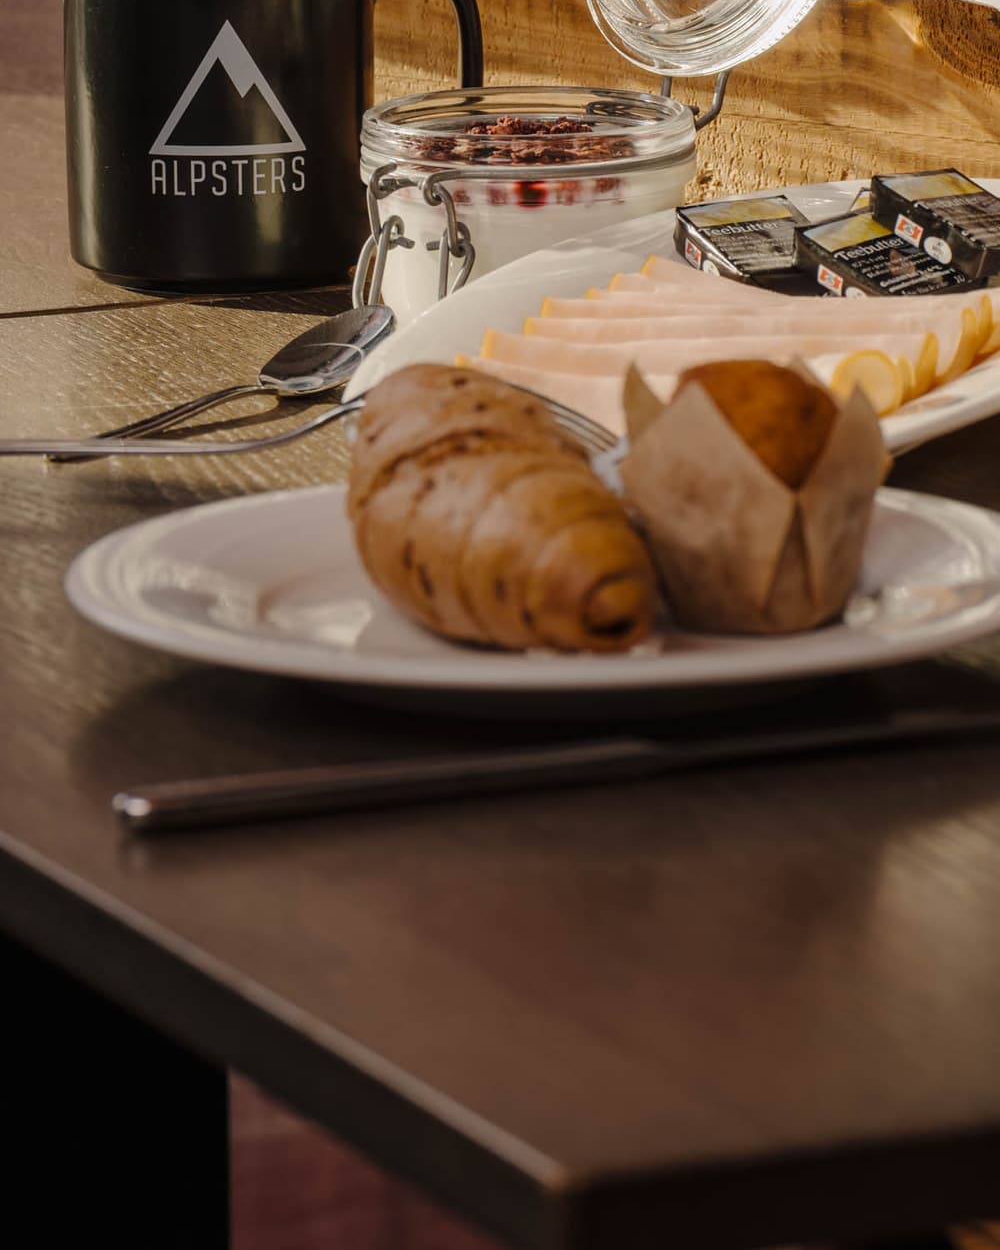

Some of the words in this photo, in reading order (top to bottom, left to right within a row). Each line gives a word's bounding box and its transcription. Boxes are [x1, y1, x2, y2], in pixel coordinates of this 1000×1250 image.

[152, 156, 305, 196] ALPSTERS
[698, 221, 779, 237] Teebutter
[834, 237, 905, 261] Teebutter
